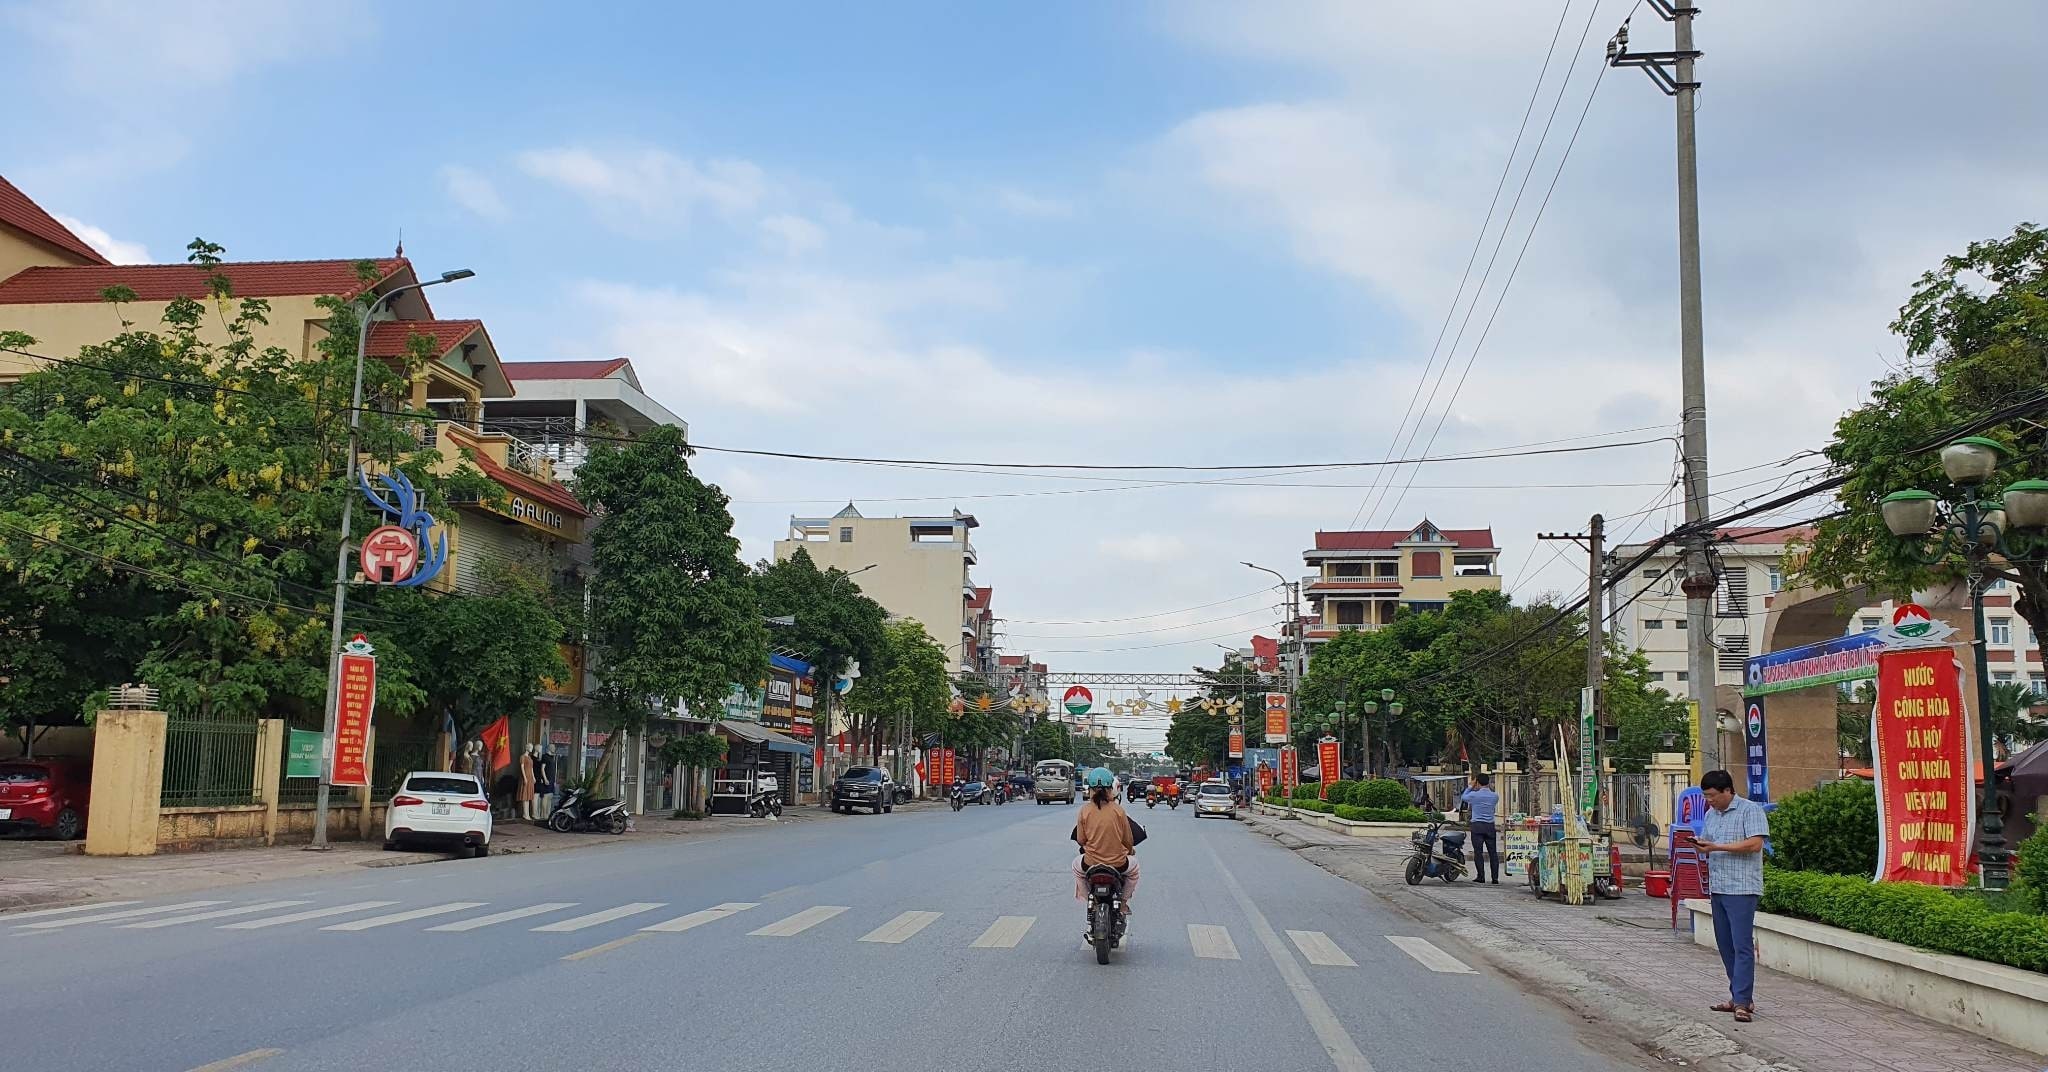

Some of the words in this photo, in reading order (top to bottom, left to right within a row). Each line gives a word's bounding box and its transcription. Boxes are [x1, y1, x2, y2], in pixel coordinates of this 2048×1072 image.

[526, 503, 562, 529] ALINA
[1903, 662, 1935, 687] NƯỚC
[1894, 695, 1924, 722] CỘNG
[1927, 693, 1950, 717] HÒA
[1906, 726, 1920, 749] XÃ
[1923, 725, 1942, 752] HỘI
[1898, 753, 1919, 780] CHỦ
[1927, 821, 1954, 843] VINH
[1924, 850, 1951, 873] NĂM
